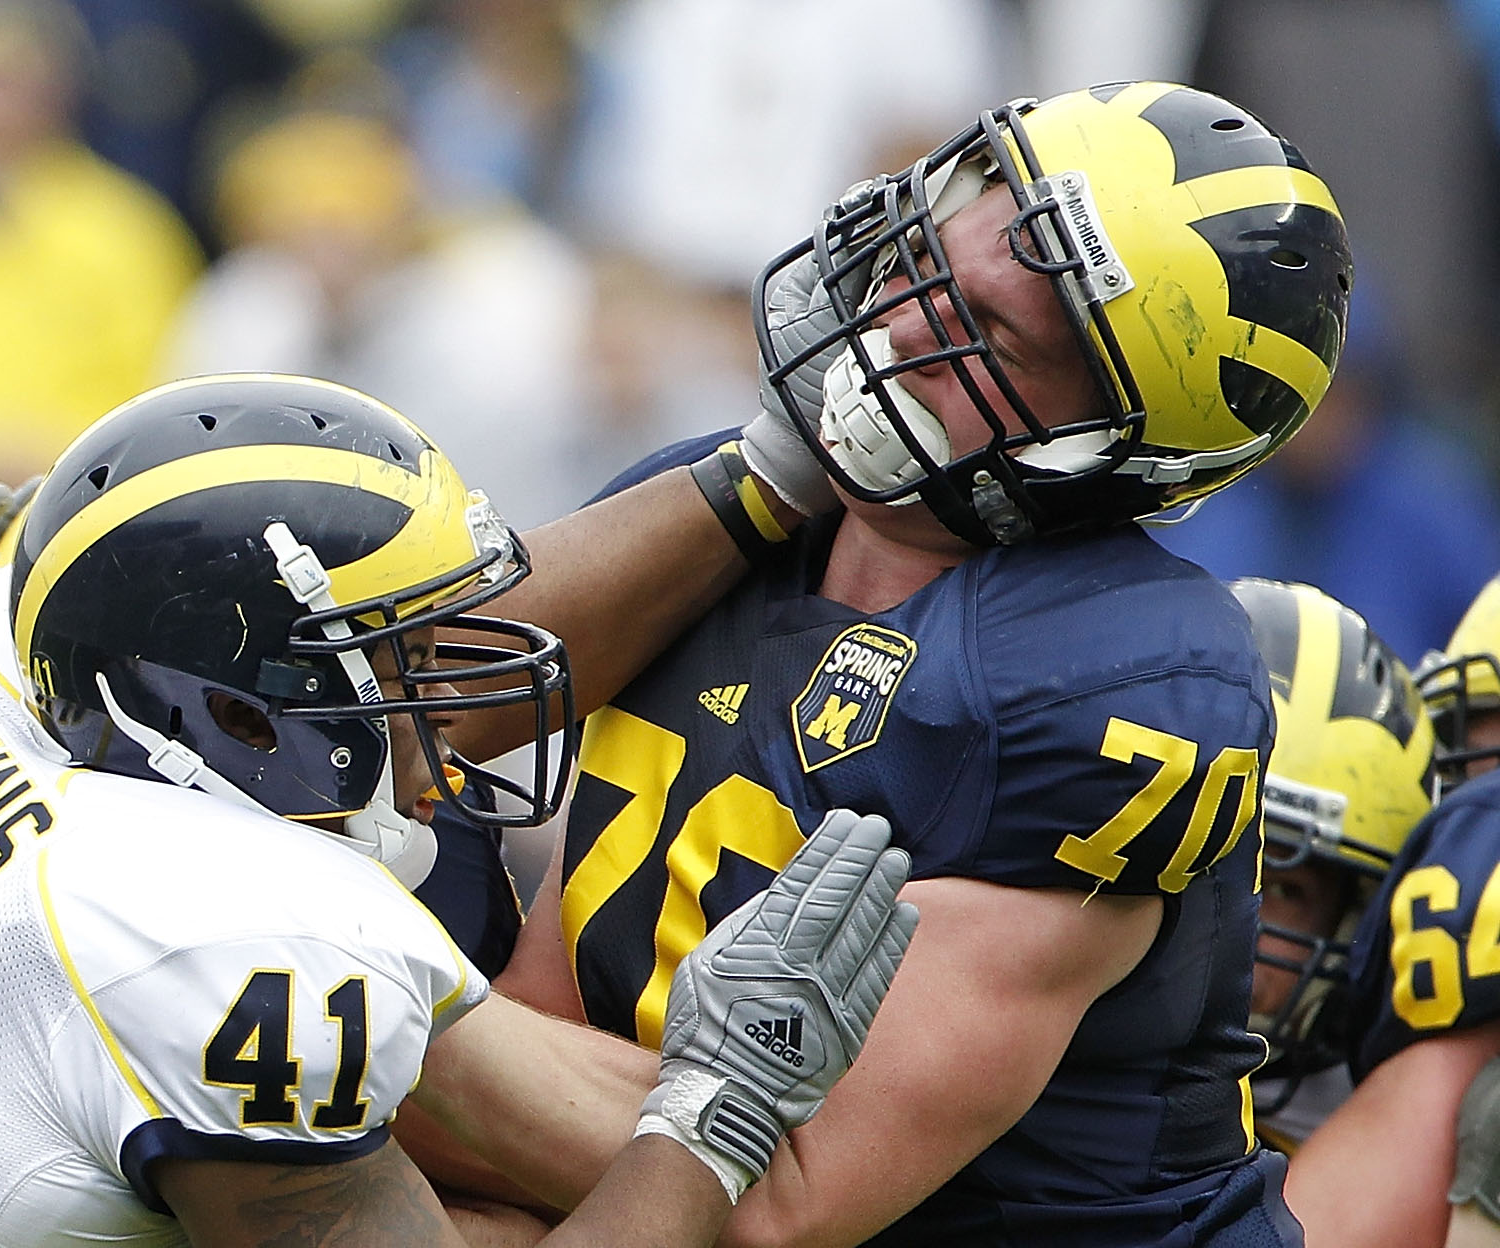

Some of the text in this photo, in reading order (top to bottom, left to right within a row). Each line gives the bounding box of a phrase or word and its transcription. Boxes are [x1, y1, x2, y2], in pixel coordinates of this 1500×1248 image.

[1067, 197, 1108, 267] MICHIGAN
[824, 641, 902, 696] SPRING
[834, 676, 871, 700] GAME
[698, 691, 739, 724] adidas
[804, 694, 861, 750] M
[1054, 717, 1259, 893] 70
[561, 704, 807, 1054] 70
[202, 967, 372, 1131] 41
[744, 1023, 805, 1068] adidas
